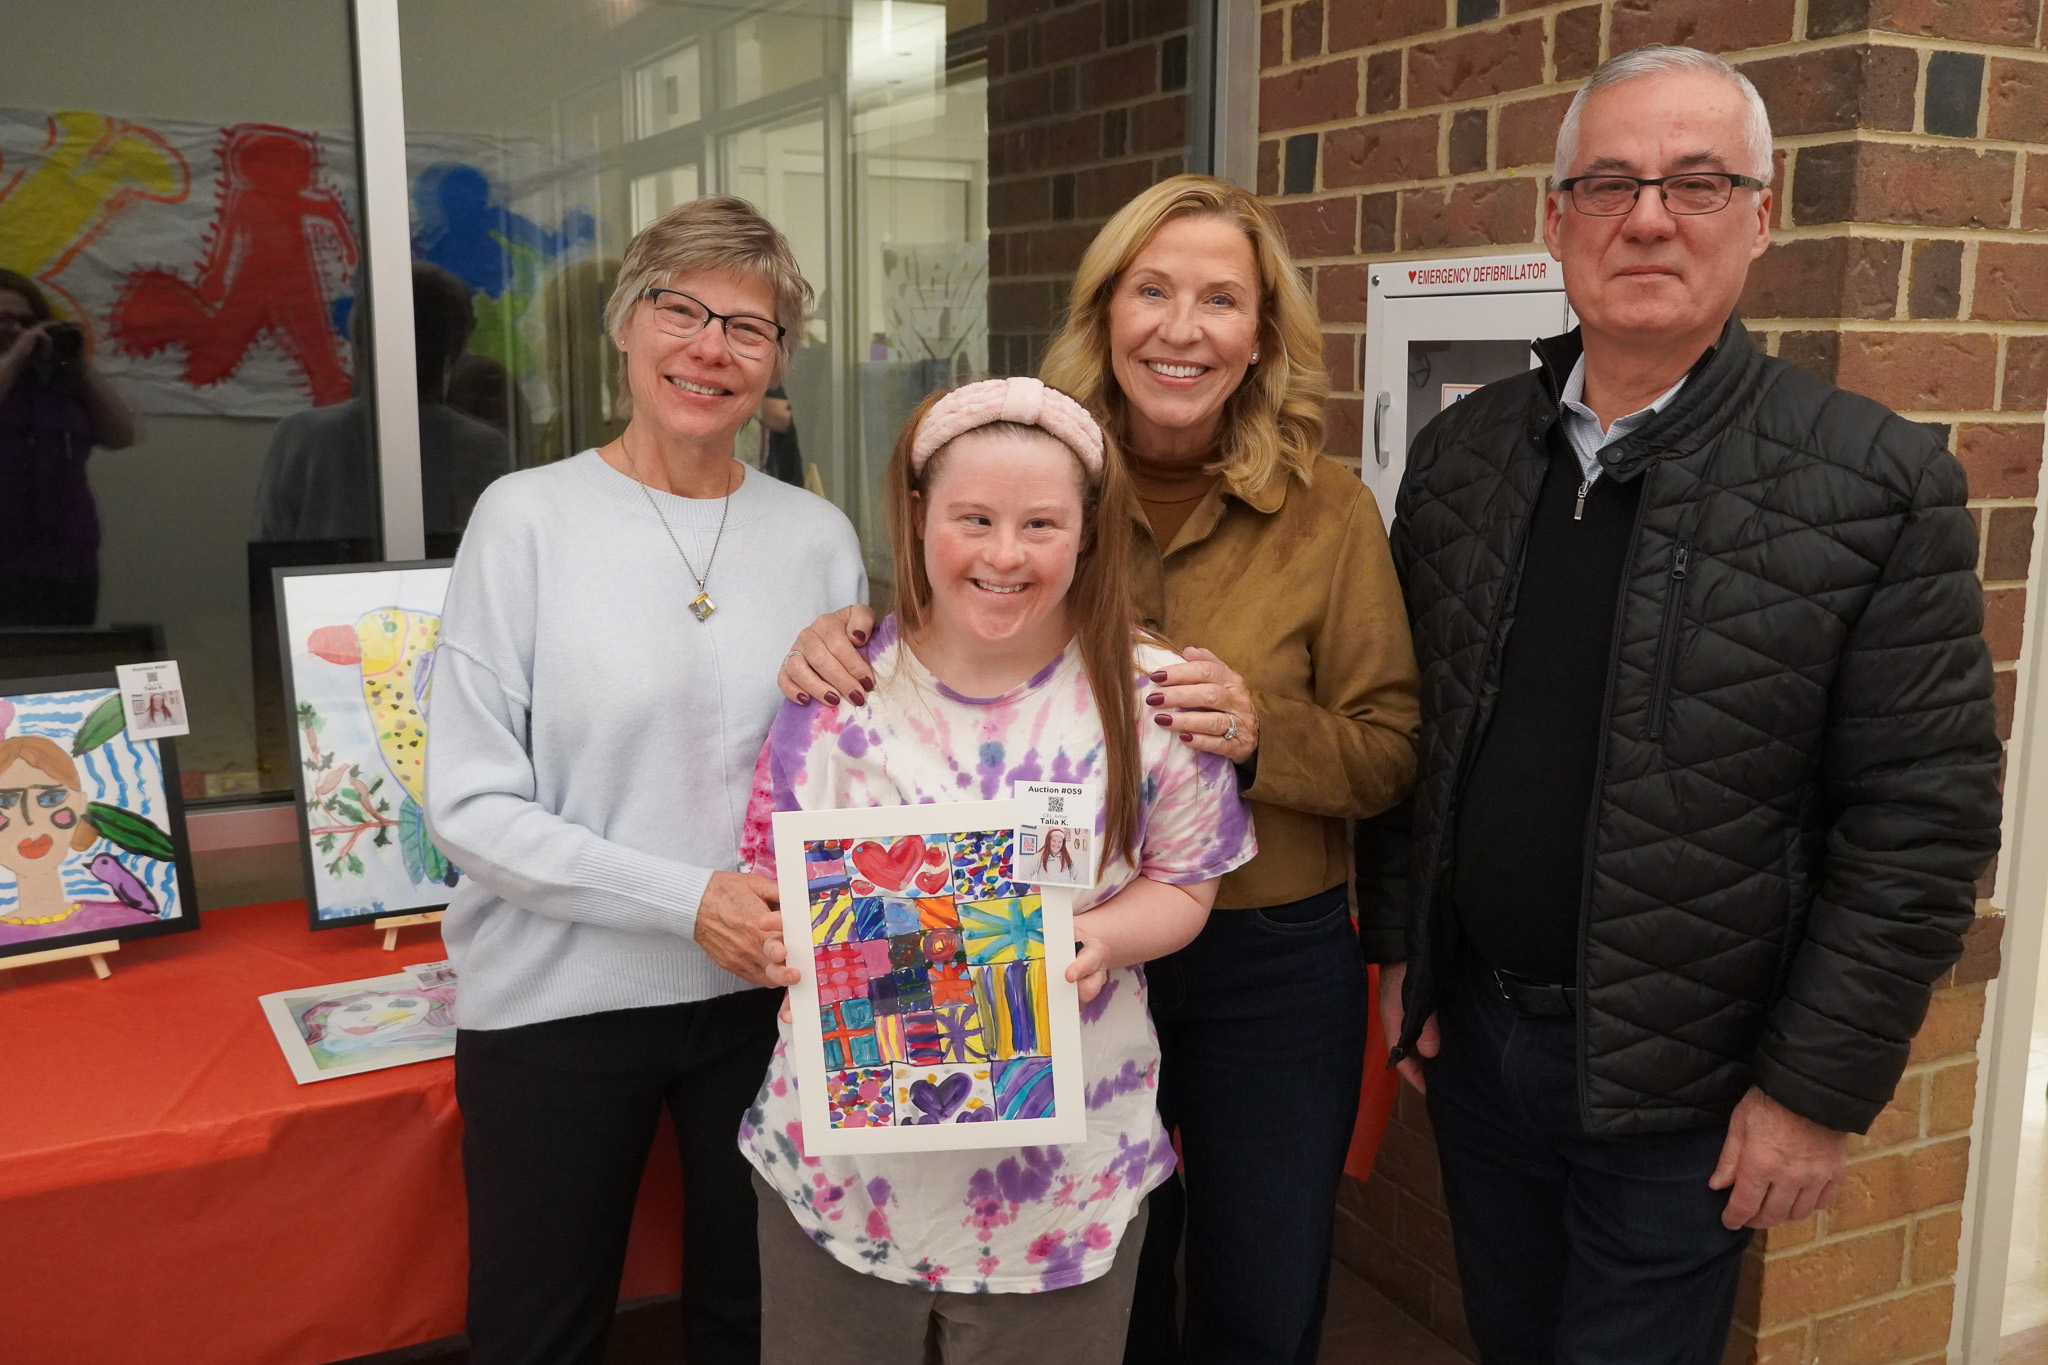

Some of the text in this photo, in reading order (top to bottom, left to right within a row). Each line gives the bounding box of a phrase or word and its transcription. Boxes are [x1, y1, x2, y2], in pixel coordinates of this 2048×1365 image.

[1417, 262, 1547, 285] EMERGENCY DEFIBRILLATOR
[1028, 786, 1082, 795] Auction #059
